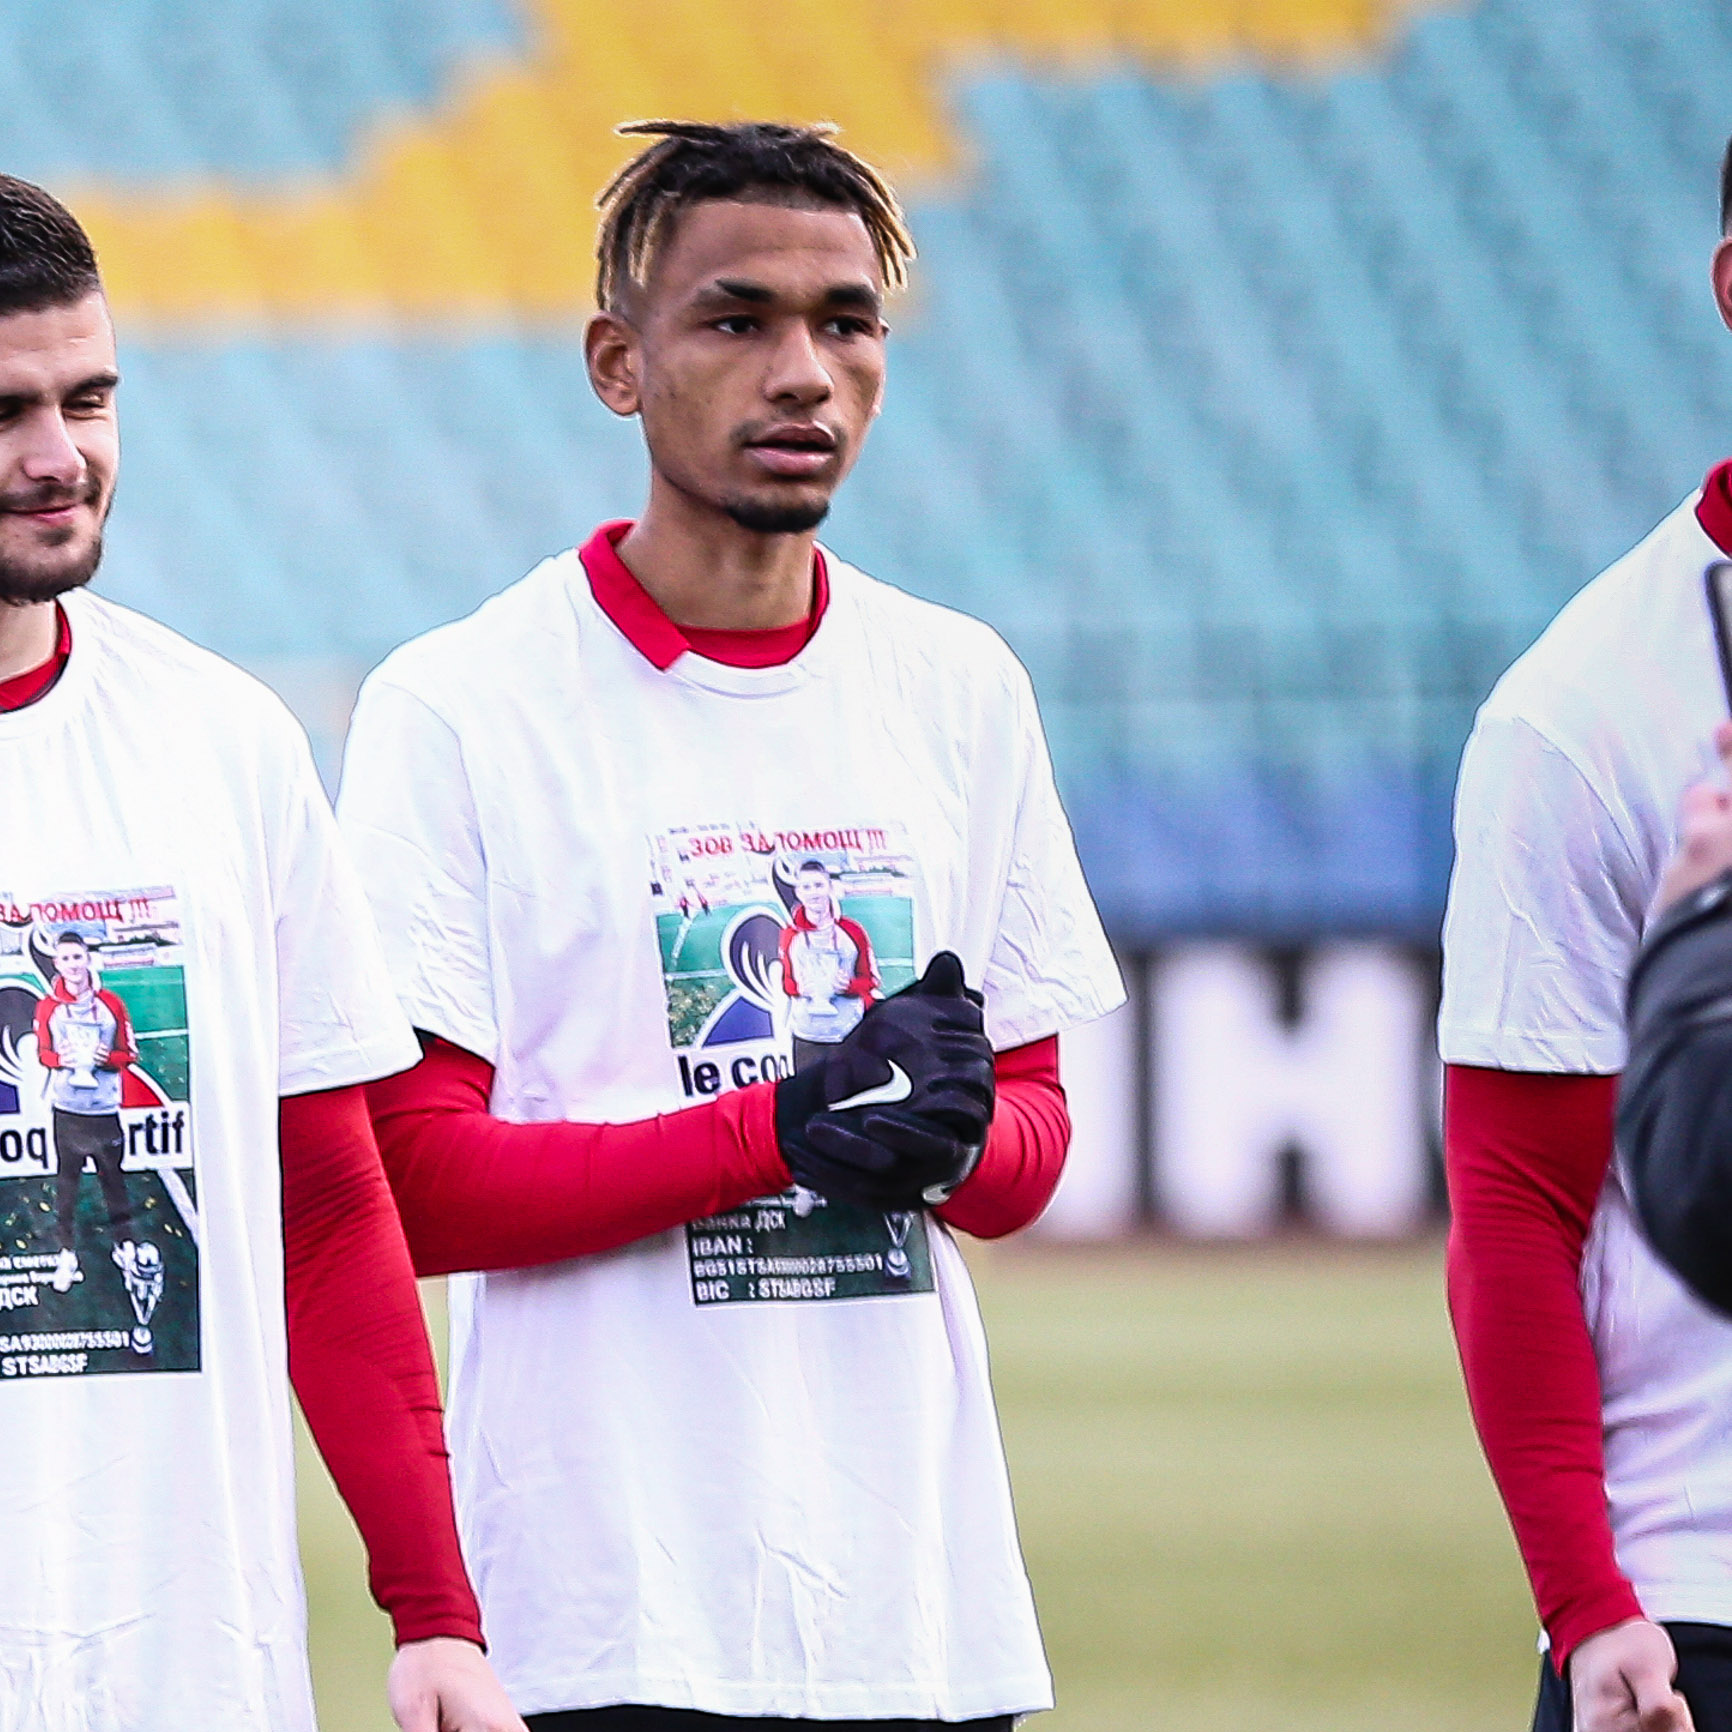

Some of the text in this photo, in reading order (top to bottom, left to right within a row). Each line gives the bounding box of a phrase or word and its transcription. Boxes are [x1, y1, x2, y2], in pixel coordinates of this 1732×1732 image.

[30, 901, 124, 922] ПОМОЩ
[677, 1056, 720, 1099] le
[127, 1111, 184, 1156] rtif
[692, 1236, 742, 1257] IBAN
